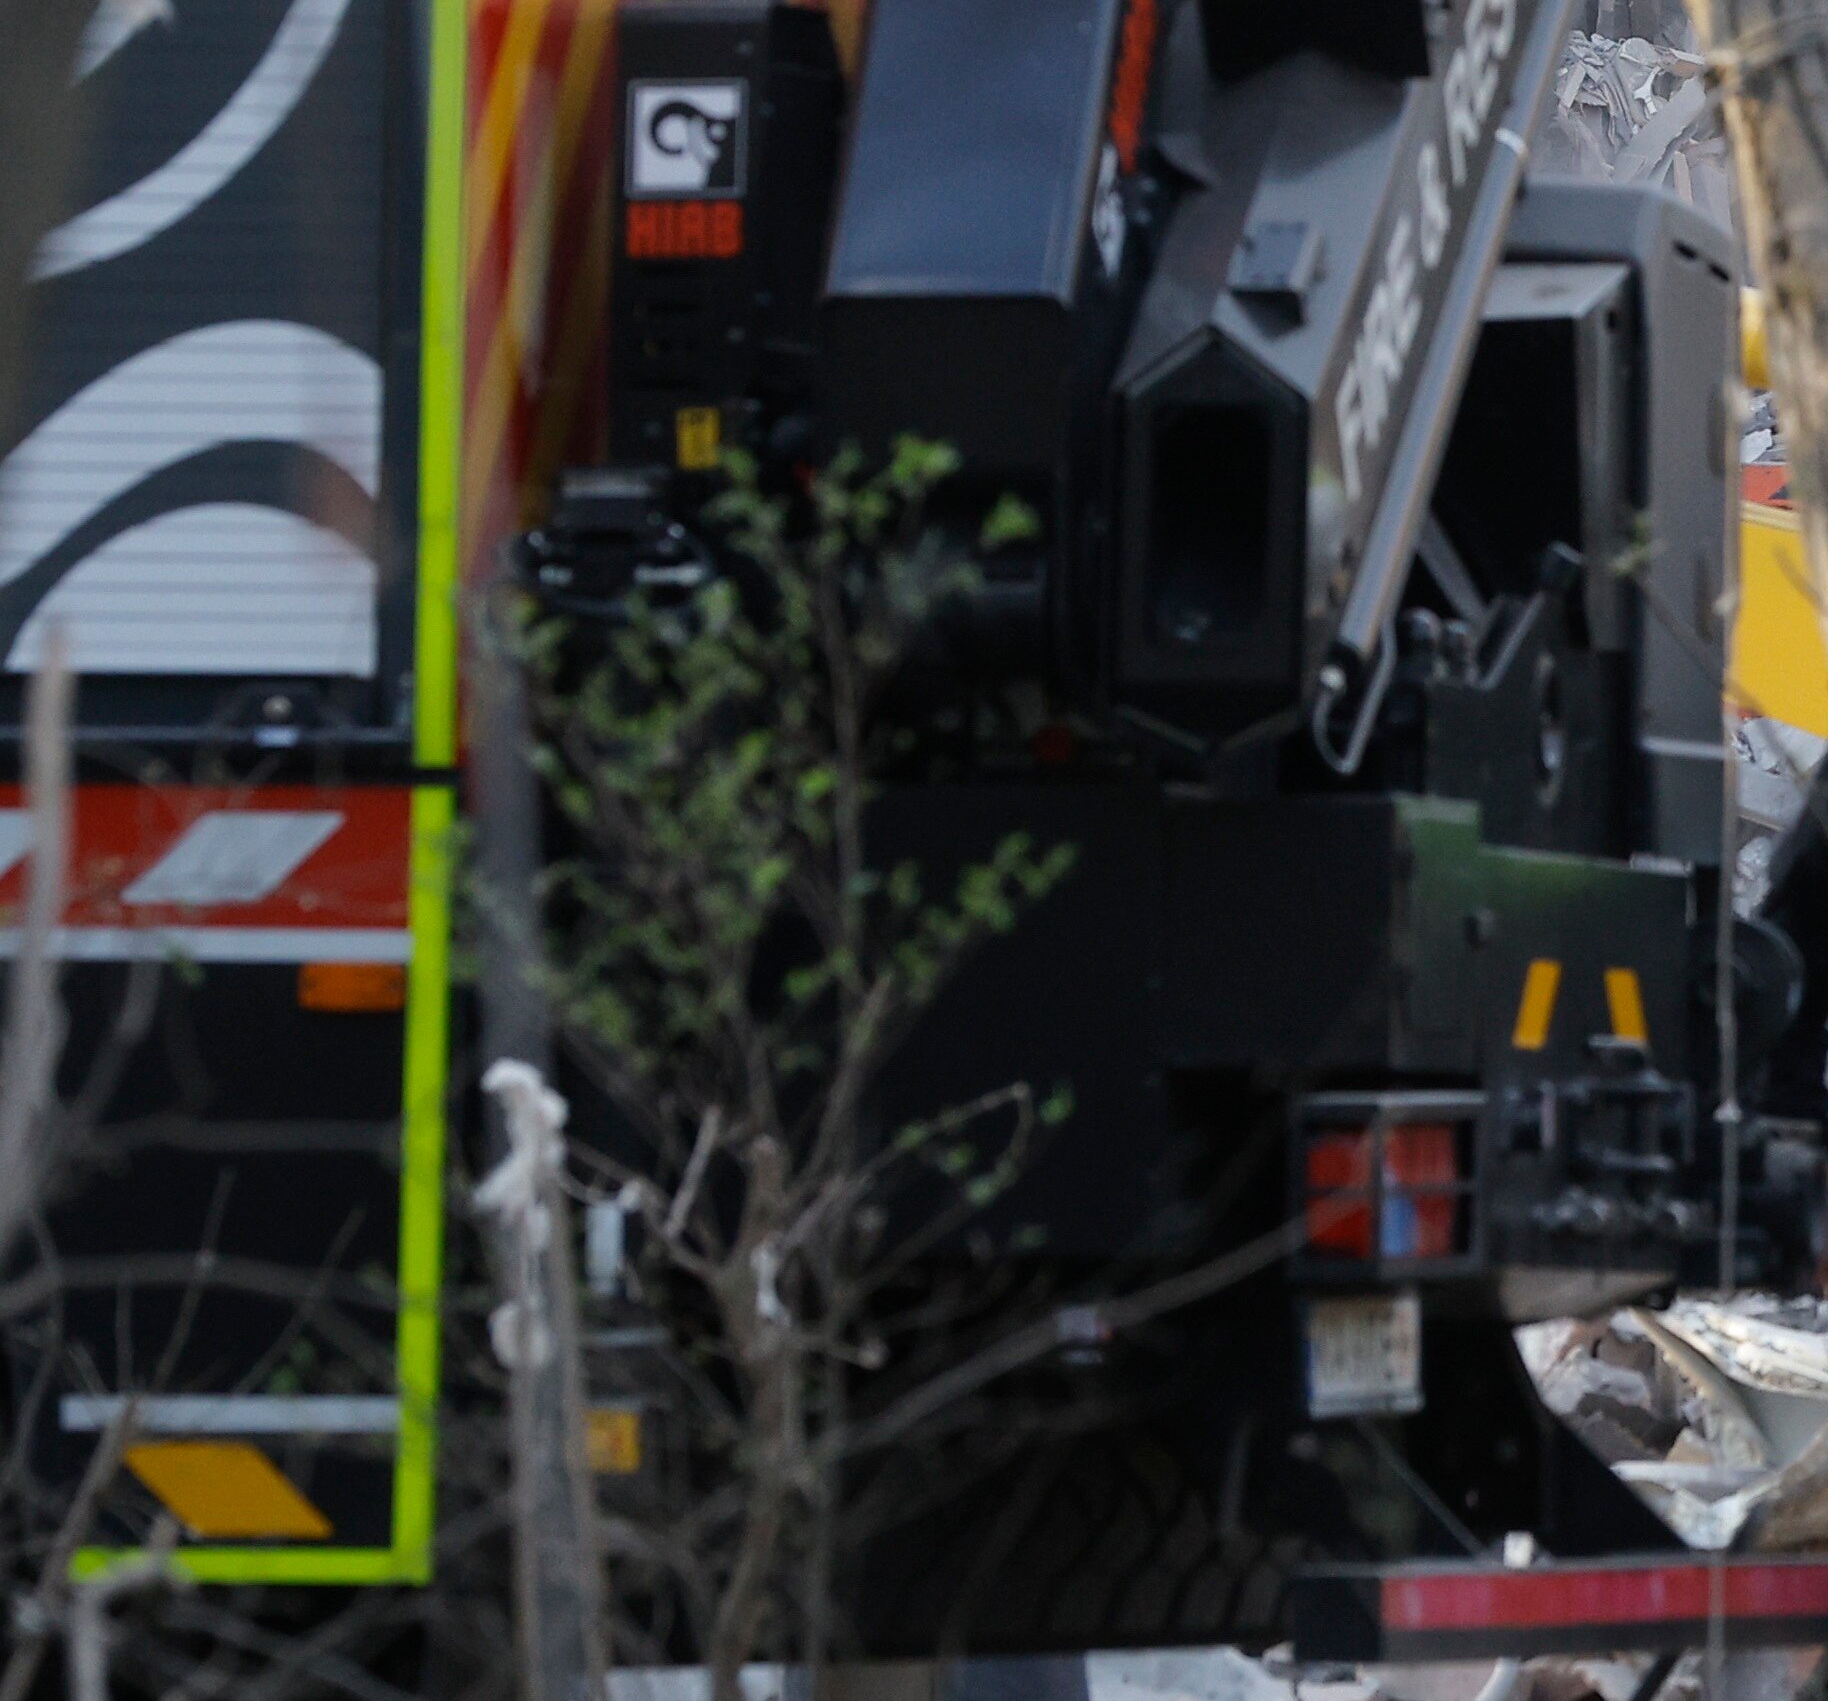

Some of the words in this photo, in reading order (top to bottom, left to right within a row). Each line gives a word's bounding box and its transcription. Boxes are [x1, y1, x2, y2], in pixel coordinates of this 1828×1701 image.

[626, 201, 743, 259] HIAB
[1336, 212, 1421, 498] FIRE
[1417, 143, 1449, 270] &
